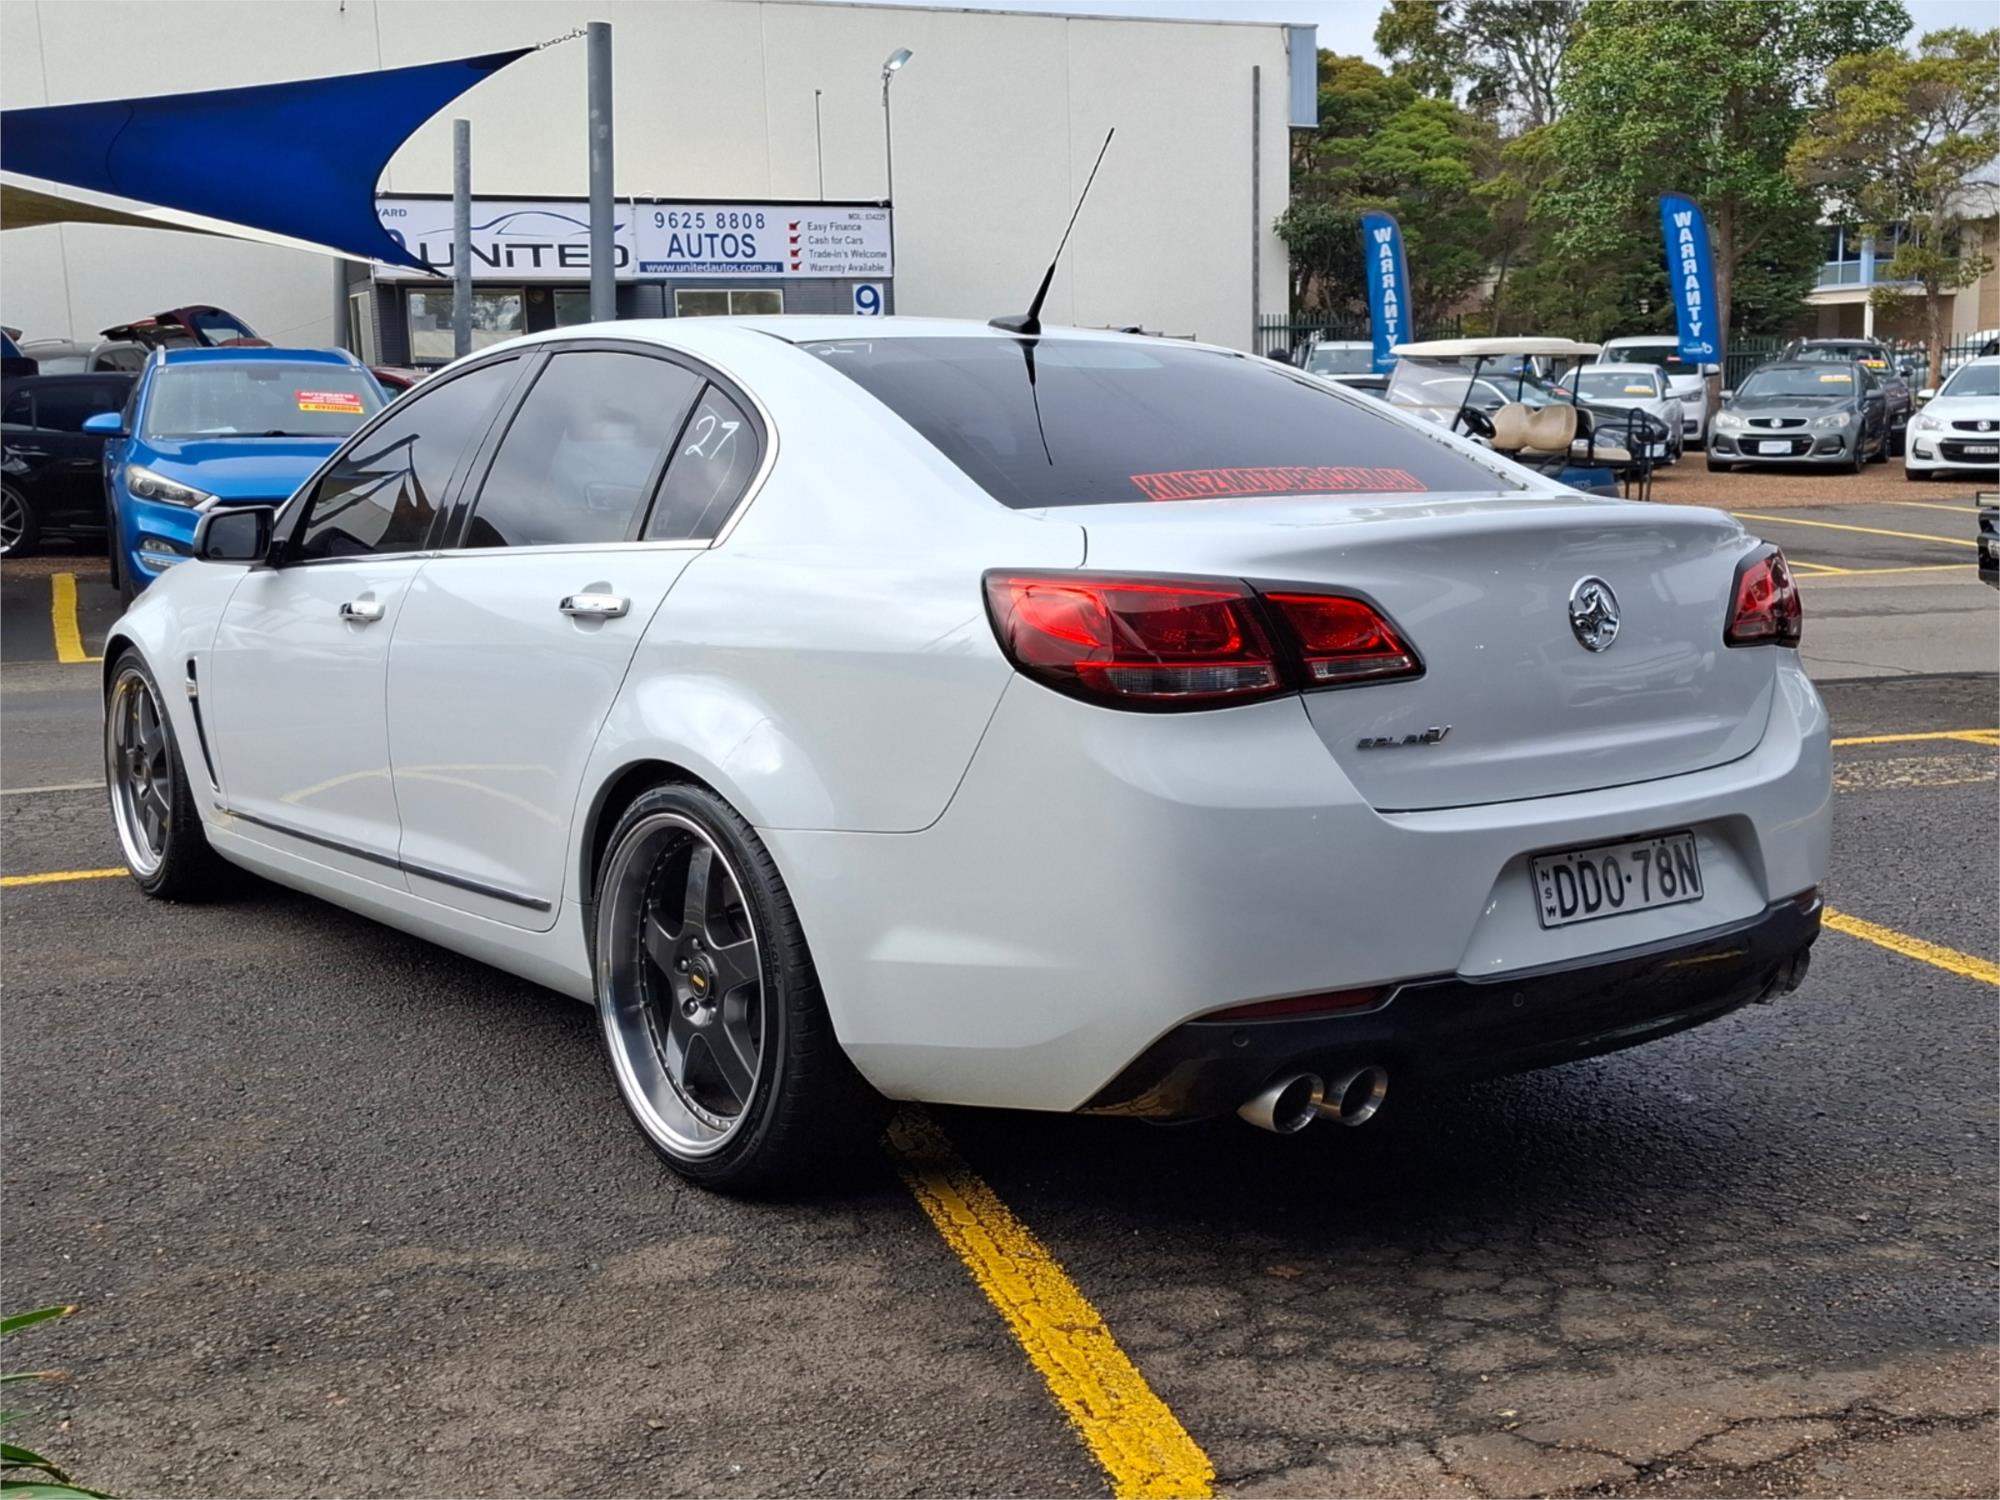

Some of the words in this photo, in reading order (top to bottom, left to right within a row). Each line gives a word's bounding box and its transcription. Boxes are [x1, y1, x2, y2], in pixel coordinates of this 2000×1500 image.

[653, 211, 706, 229] 9625
[716, 212, 766, 229] 8808
[807, 222, 827, 232] Easy
[829, 222, 862, 231] Finance
[667, 232, 757, 258] AUTOS
[808, 236, 830, 245] Cash
[831, 236, 843, 244] for
[845, 236, 864, 245] Cars
[850, 250, 888, 258] Welcome
[645, 263, 778, 273] www.unitedautos.com.au
[809, 263, 846, 274] Warranty
[847, 264, 885, 272] Available
[855, 284, 880, 316] 9
[684, 415, 741, 461] 27
